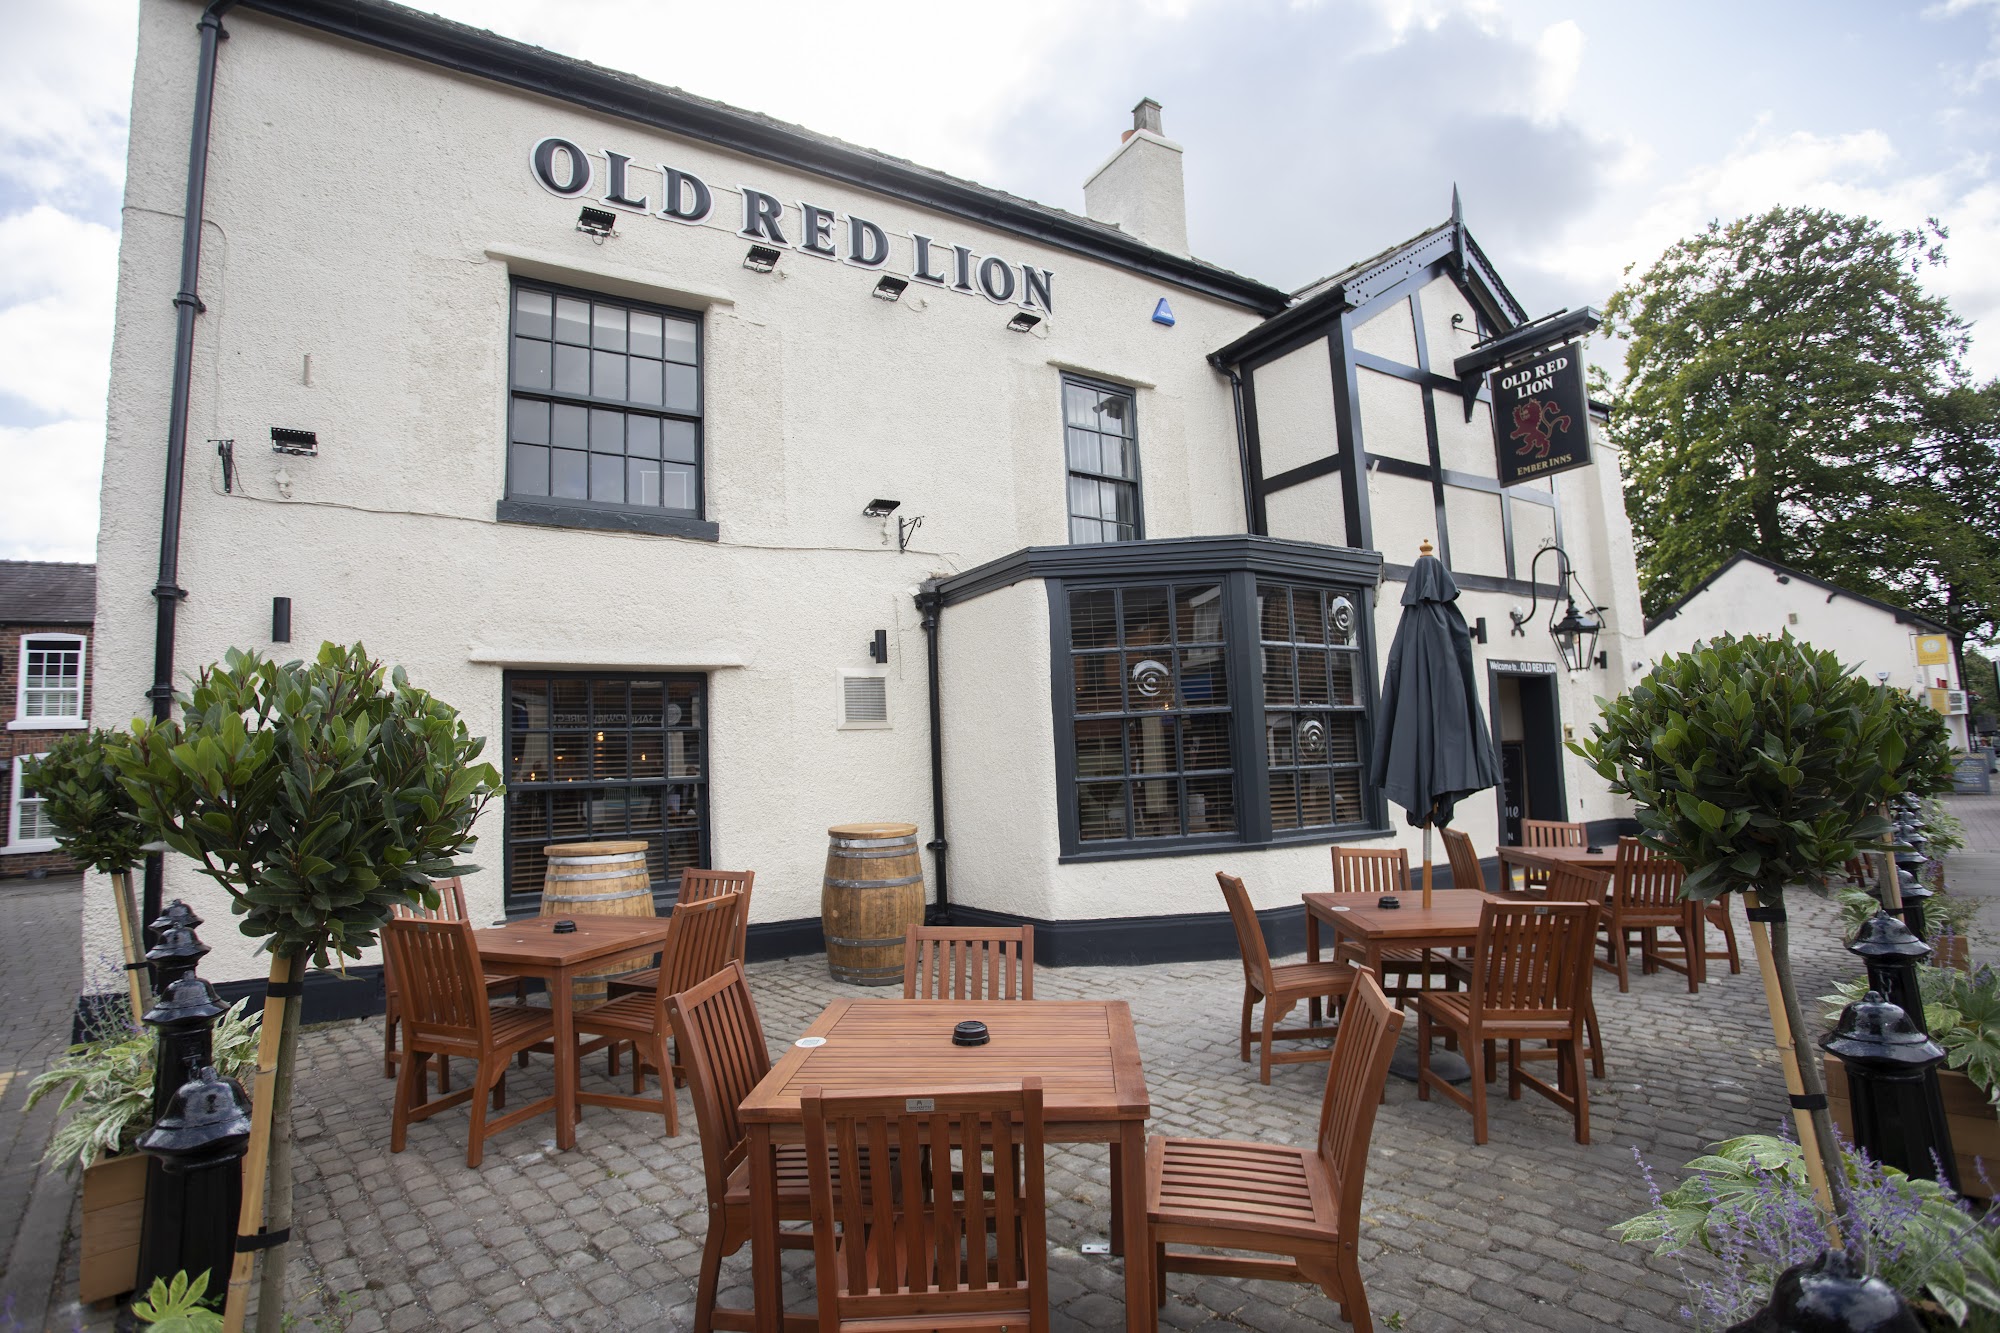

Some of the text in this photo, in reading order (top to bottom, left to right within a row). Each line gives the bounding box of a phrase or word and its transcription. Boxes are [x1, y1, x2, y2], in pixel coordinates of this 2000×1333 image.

[529, 136, 1055, 320] OLD RED LION
[1501, 357, 1568, 390] OLD RED
[1517, 376, 1554, 399] LION
[1517, 453, 1572, 476] EMBER INNS
[1490, 661, 1511, 671] Welcome
[1520, 662, 1532, 673] OLD
[1532, 662, 1543, 673] RED
[1543, 663, 1556, 673] LION
